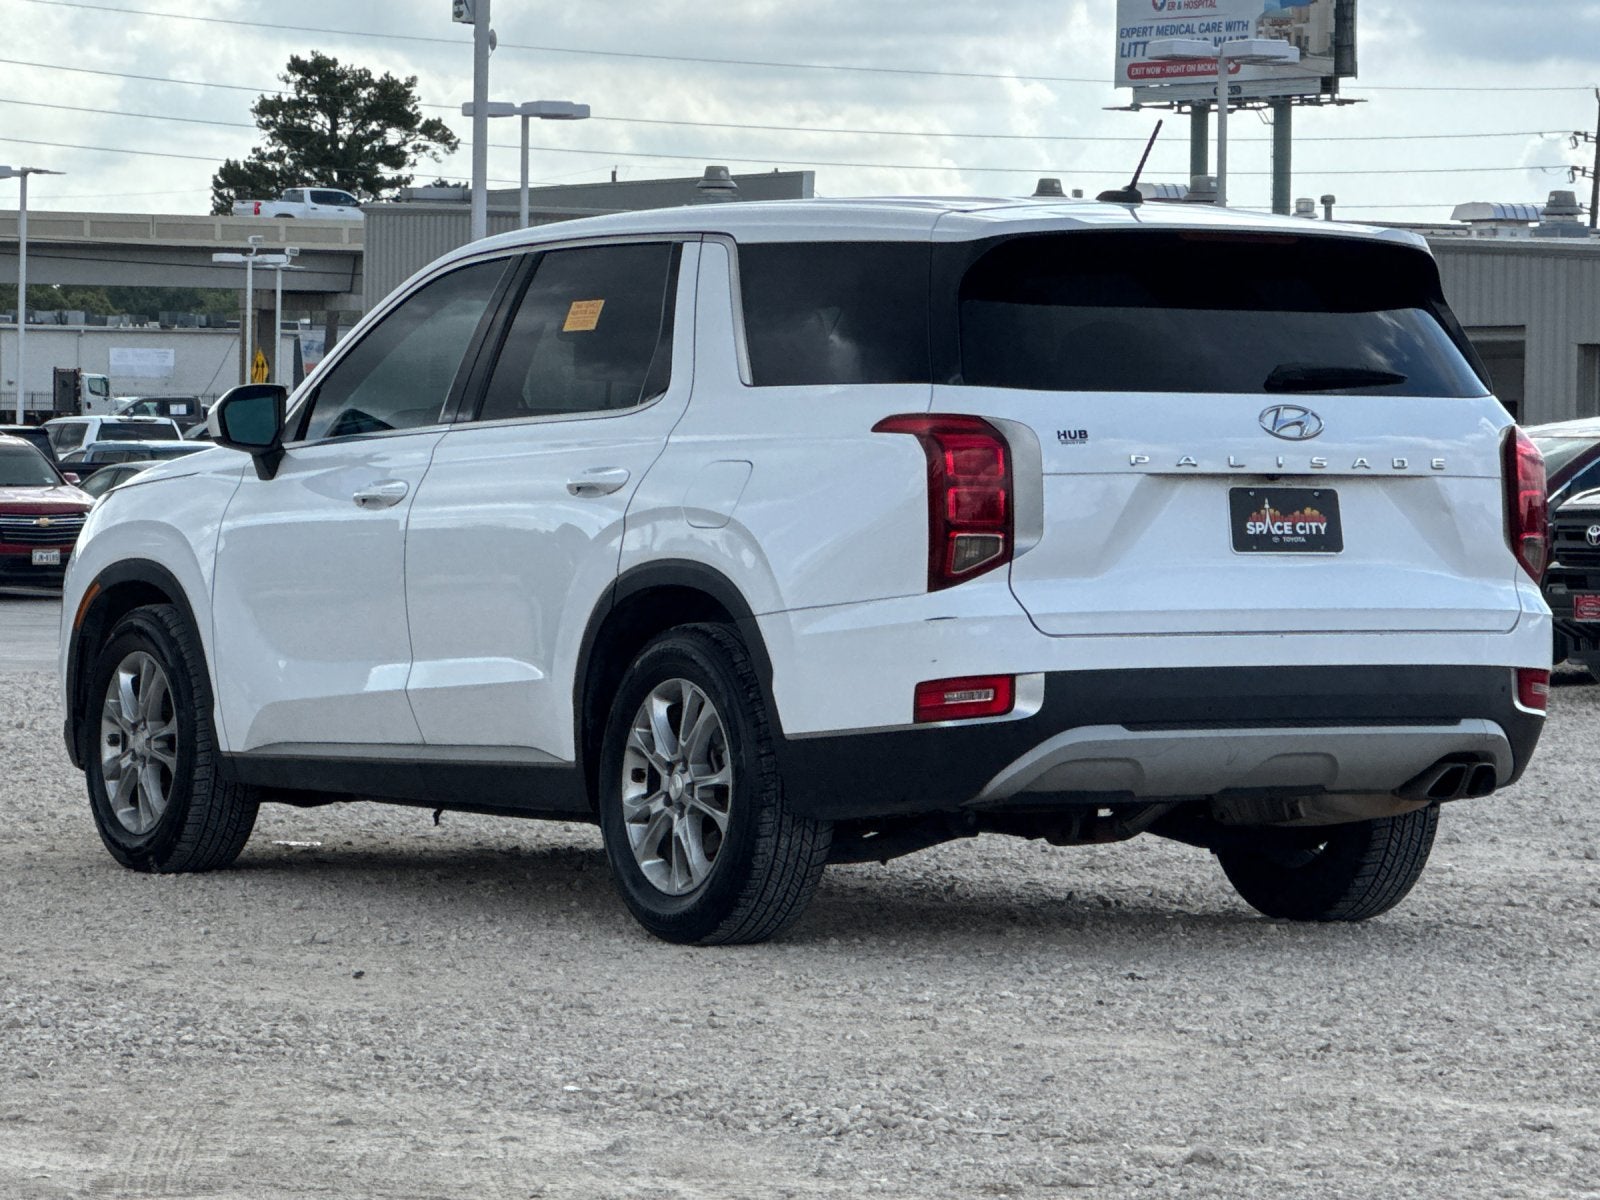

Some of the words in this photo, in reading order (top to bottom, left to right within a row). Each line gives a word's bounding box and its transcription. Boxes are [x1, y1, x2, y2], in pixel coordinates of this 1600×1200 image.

[1167, 1, 1176, 11] ER
[1184, 0, 1217, 10] HOSPITAL
[1120, 25, 1154, 39] EXPERT
[1156, 23, 1197, 36] MEDICAL
[1199, 22, 1222, 34] CARE
[1225, 20, 1250, 32] WITH
[1131, 67, 1145, 76] EXIT
[1146, 66, 1161, 75] NOW
[1166, 65, 1186, 74] RIGHT
[1187, 64, 1196, 73] ON
[1056, 429, 1089, 440] HUB
[1129, 454, 1446, 471] PALISADE
[1246, 520, 1293, 535] SPACE
[1296, 521, 1328, 535] CITY
